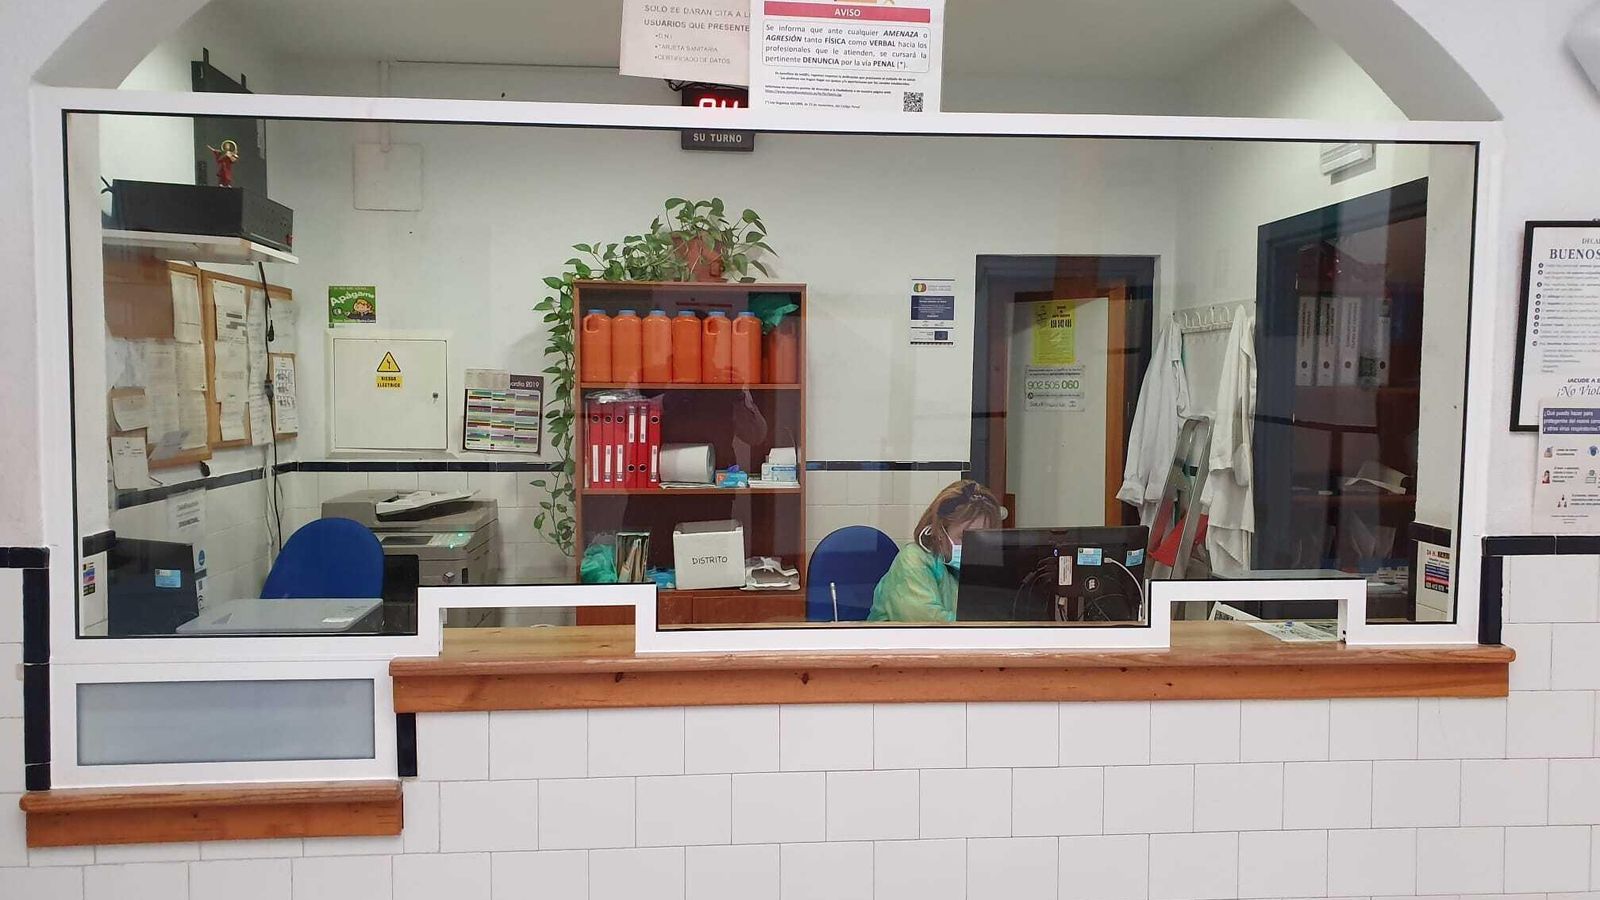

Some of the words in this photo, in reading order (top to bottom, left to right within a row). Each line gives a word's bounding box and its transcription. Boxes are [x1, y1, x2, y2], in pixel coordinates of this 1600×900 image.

[644, 5, 667, 13] SOLO
[683, 7, 712, 16] DARAN
[715, 9, 734, 17] CITA
[834, 8, 861, 17] AVISO
[644, 19, 686, 29] USUARIOS
[689, 22, 705, 30] QUE
[779, 25, 806, 33] informa
[847, 28, 879, 37] cualquier
[883, 30, 919, 38] AMENAZA
[765, 34, 802, 43] AGRESIÓN
[825, 36, 846, 45] FÍSICA
[869, 40, 896, 48] VERBAL
[765, 44, 811, 54] profesionales
[832, 47, 839, 55] le
[843, 48, 876, 57] atienden,
[765, 55, 801, 65] pertinente
[802, 57, 840, 65] DENUNCIA
[873, 60, 896, 68] PENAL
[693, 133, 705, 141] SU
[710, 133, 742, 143] TURNO
[1550, 248, 1600, 260] BUENOS
[1027, 380, 1044, 390] 902
[1061, 379, 1079, 389] 060
[692, 556, 728, 565] DISTRITO
